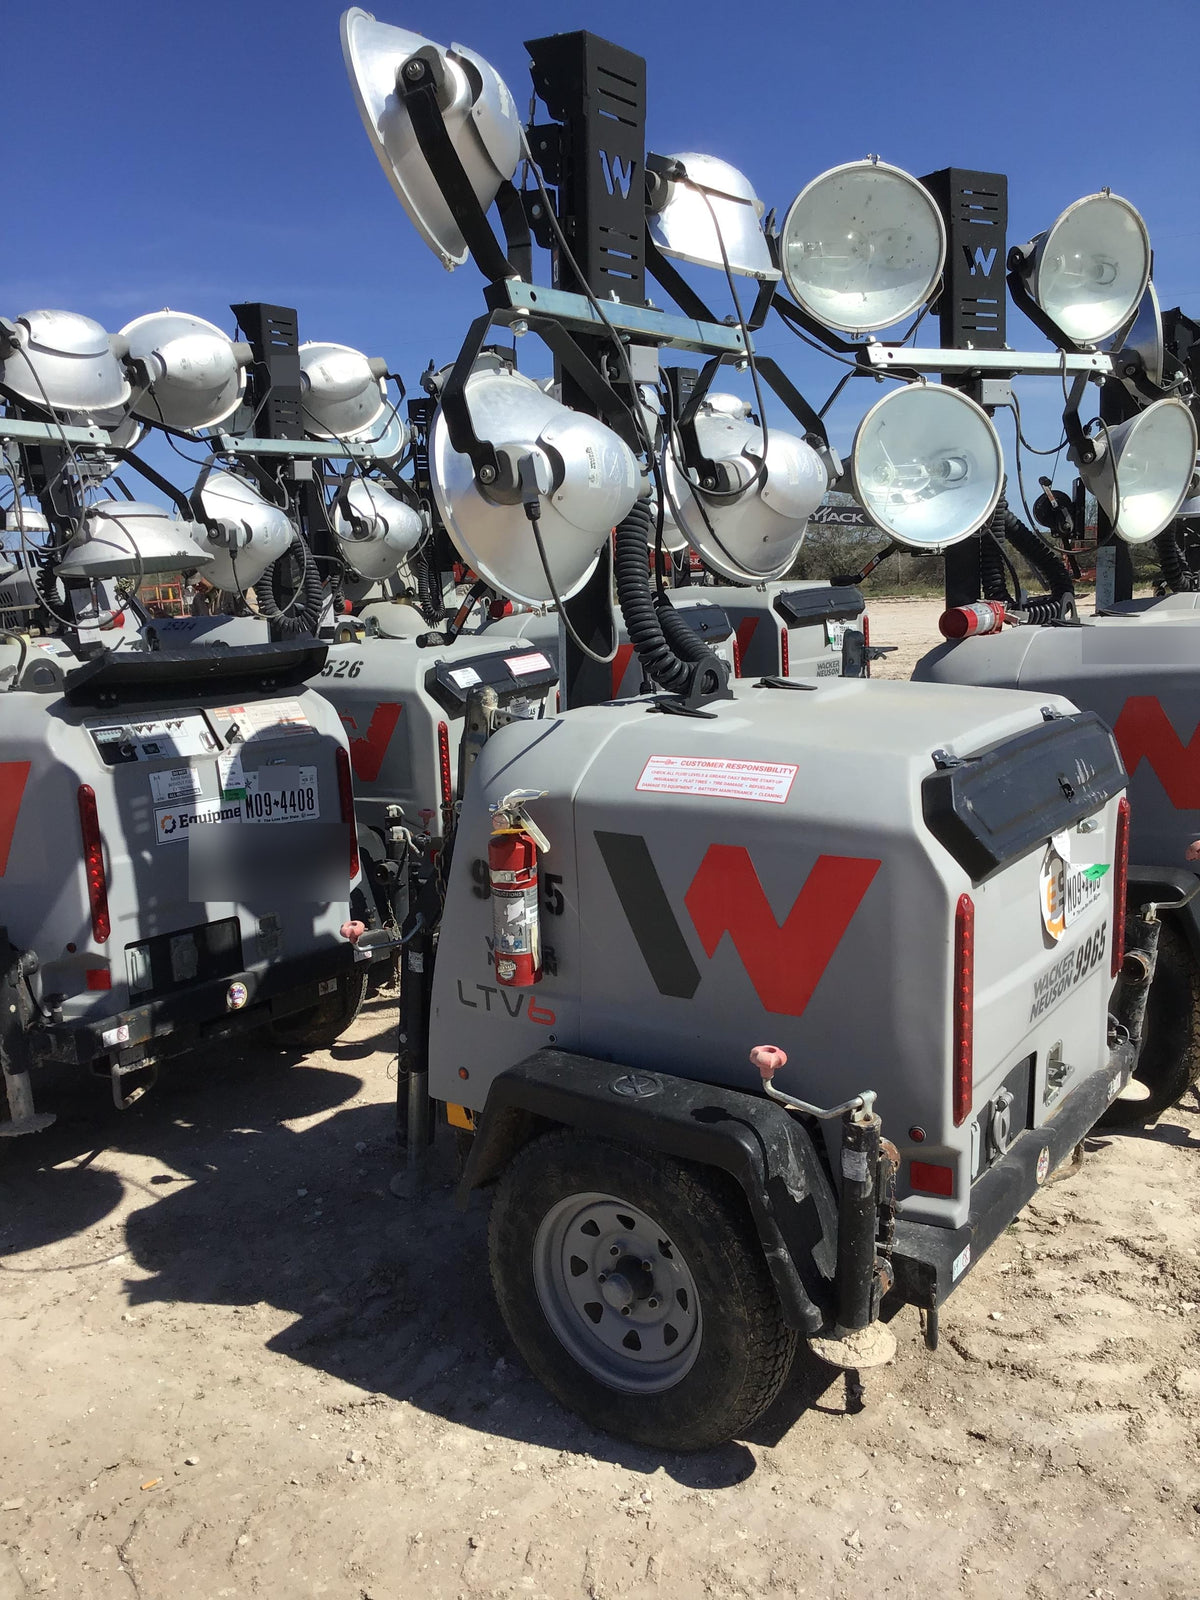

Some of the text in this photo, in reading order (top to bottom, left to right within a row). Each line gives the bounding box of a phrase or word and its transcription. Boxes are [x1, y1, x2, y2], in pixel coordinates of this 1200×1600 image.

[816, 668, 840, 678] NEUSON
[817, 660, 840, 670] WACKER
[680, 760, 725, 769] CUSTOMER
[726, 762, 794, 775] RESPONSIBILITY
[280, 788, 314, 814] 4408
[1074, 920, 1106, 984] 9965
[1034, 950, 1074, 999] WACKER
[1030, 970, 1074, 1023] NEUSON
